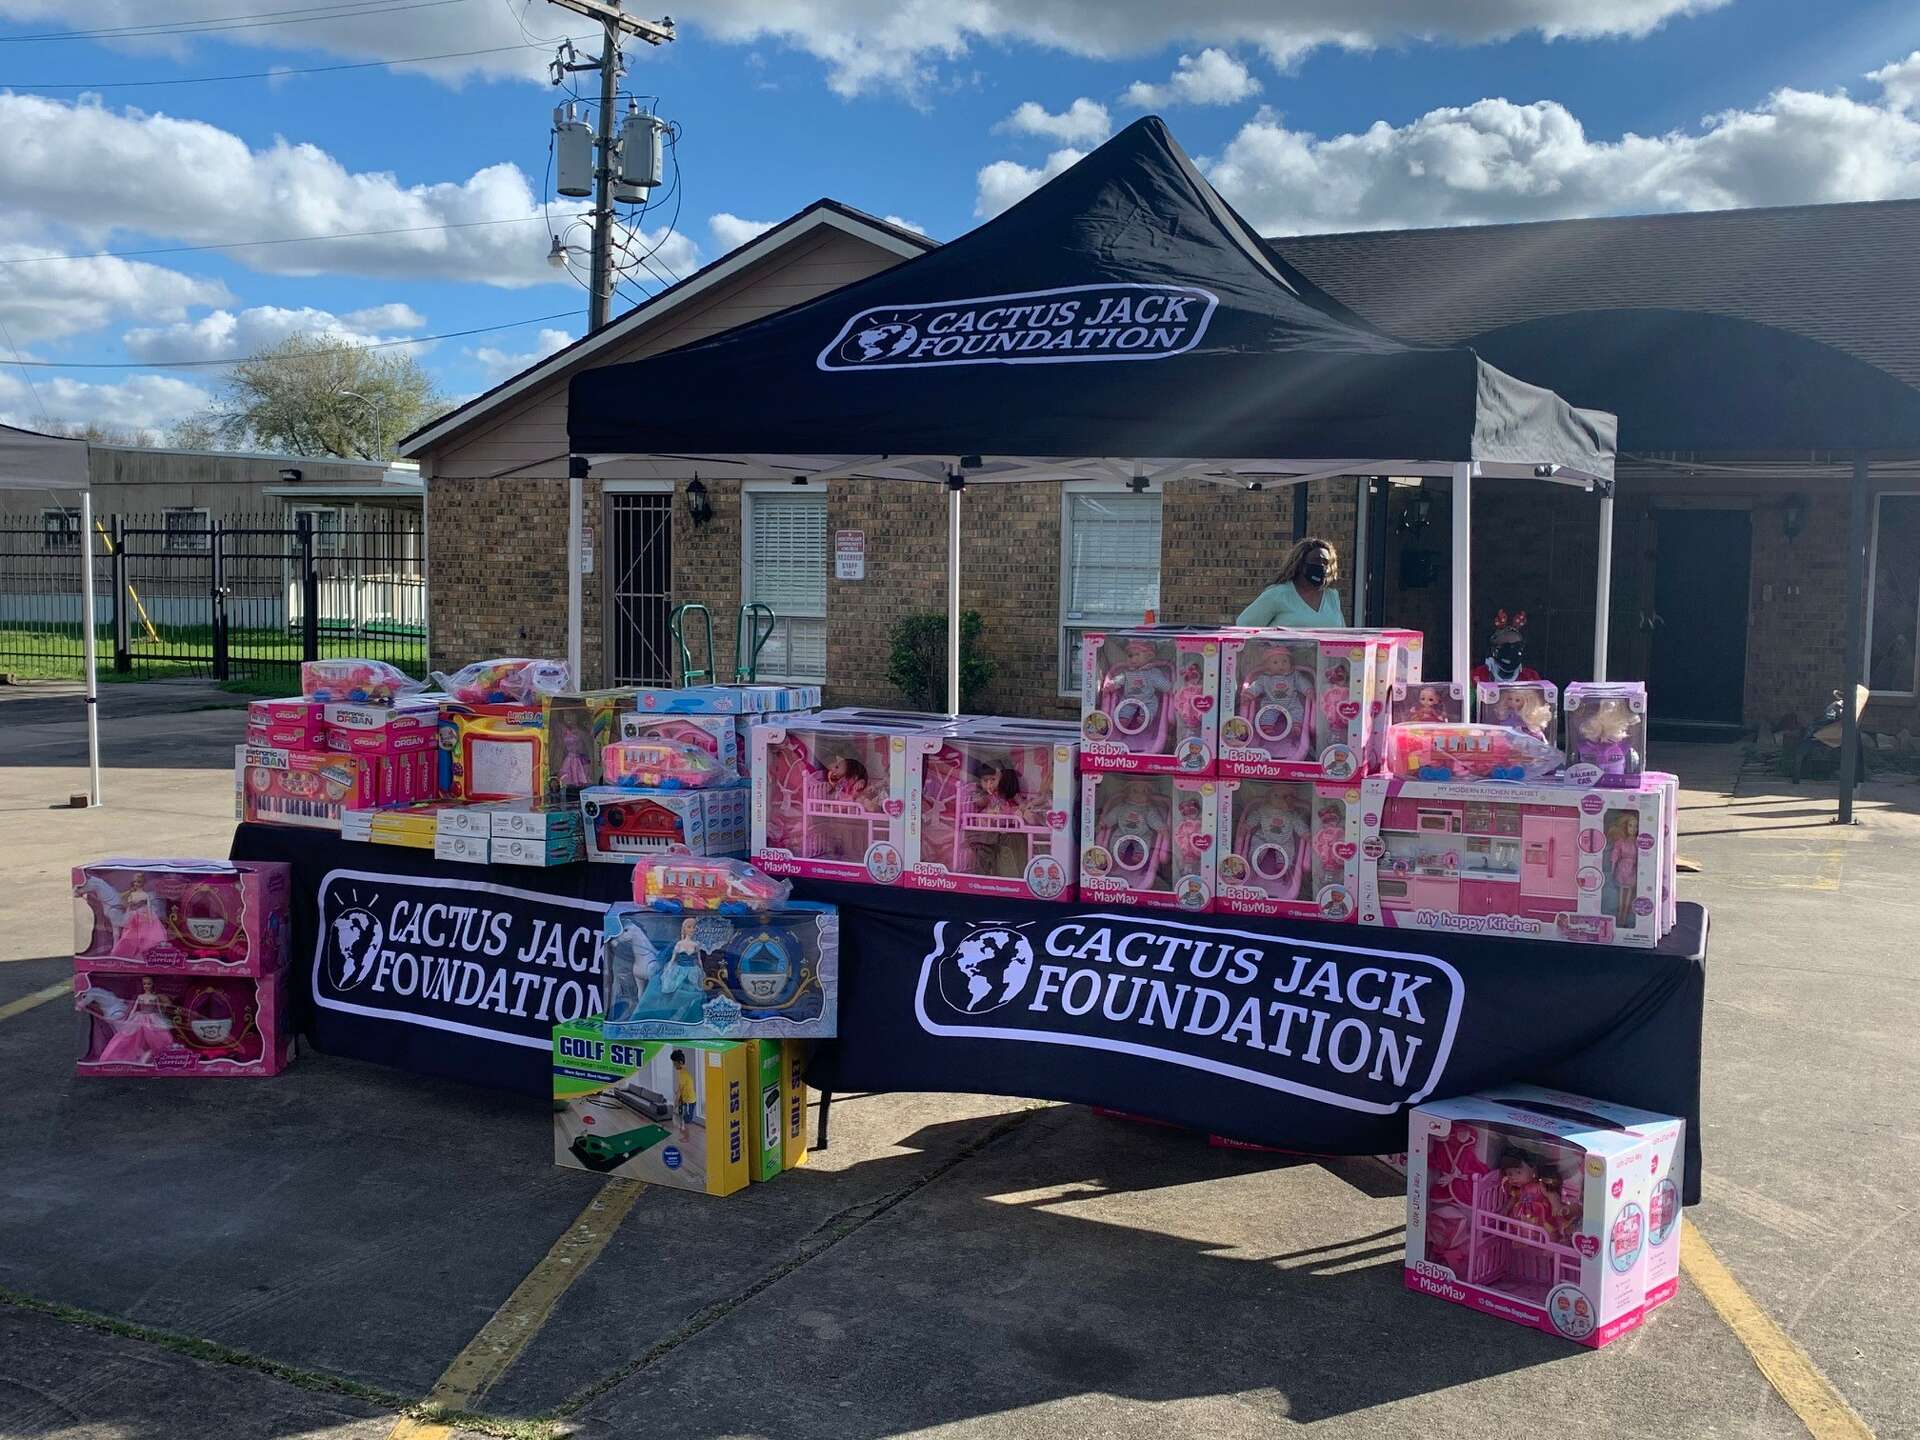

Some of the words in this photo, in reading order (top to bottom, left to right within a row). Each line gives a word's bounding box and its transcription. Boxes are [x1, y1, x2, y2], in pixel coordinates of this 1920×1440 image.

[926, 301, 1080, 335] CACTUS
[1084, 295, 1197, 326] JACK
[908, 326, 1185, 358] FOUNDATION
[275, 712, 300, 720] ORGAN
[336, 715, 374, 726] ORGAN
[392, 720, 417, 729] ORGAN
[272, 734, 297, 742] ORGAN
[354, 738, 379, 746] ORGAN
[393, 737, 424, 748] ORGAN
[1090, 743, 1121, 756] Baby
[1229, 750, 1262, 762] Baby
[245, 755, 287, 768] ORGAN
[1094, 756, 1139, 768] MayMay
[1233, 763, 1281, 776] MayMay
[760, 849, 785, 861] Baby
[763, 861, 802, 874] MayMay
[913, 863, 940, 877] Baby
[917, 876, 957, 889] MayMay
[1090, 879, 1121, 891] Baby
[1094, 892, 1138, 905] MayMay
[1227, 887, 1259, 900] Baby
[1231, 901, 1278, 914] MayMay
[389, 900, 513, 956] CACTUS
[1417, 911, 1438, 928] My
[1441, 910, 1486, 931] happy
[1486, 915, 1540, 934] Kitchen
[1044, 924, 1263, 985] CACTUS
[1273, 956, 1432, 1024] JACK
[1028, 964, 1423, 1087] FOUNDATION
[559, 1036, 605, 1061] GOLF
[610, 1043, 645, 1068] SET
[791, 1059, 800, 1090] SET
[729, 1080, 740, 1114] SET
[791, 1095, 800, 1139] GOLF
[730, 1120, 741, 1163] GOLF
[1415, 1260, 1448, 1282] Baby
[1420, 1277, 1466, 1300] MayMay
